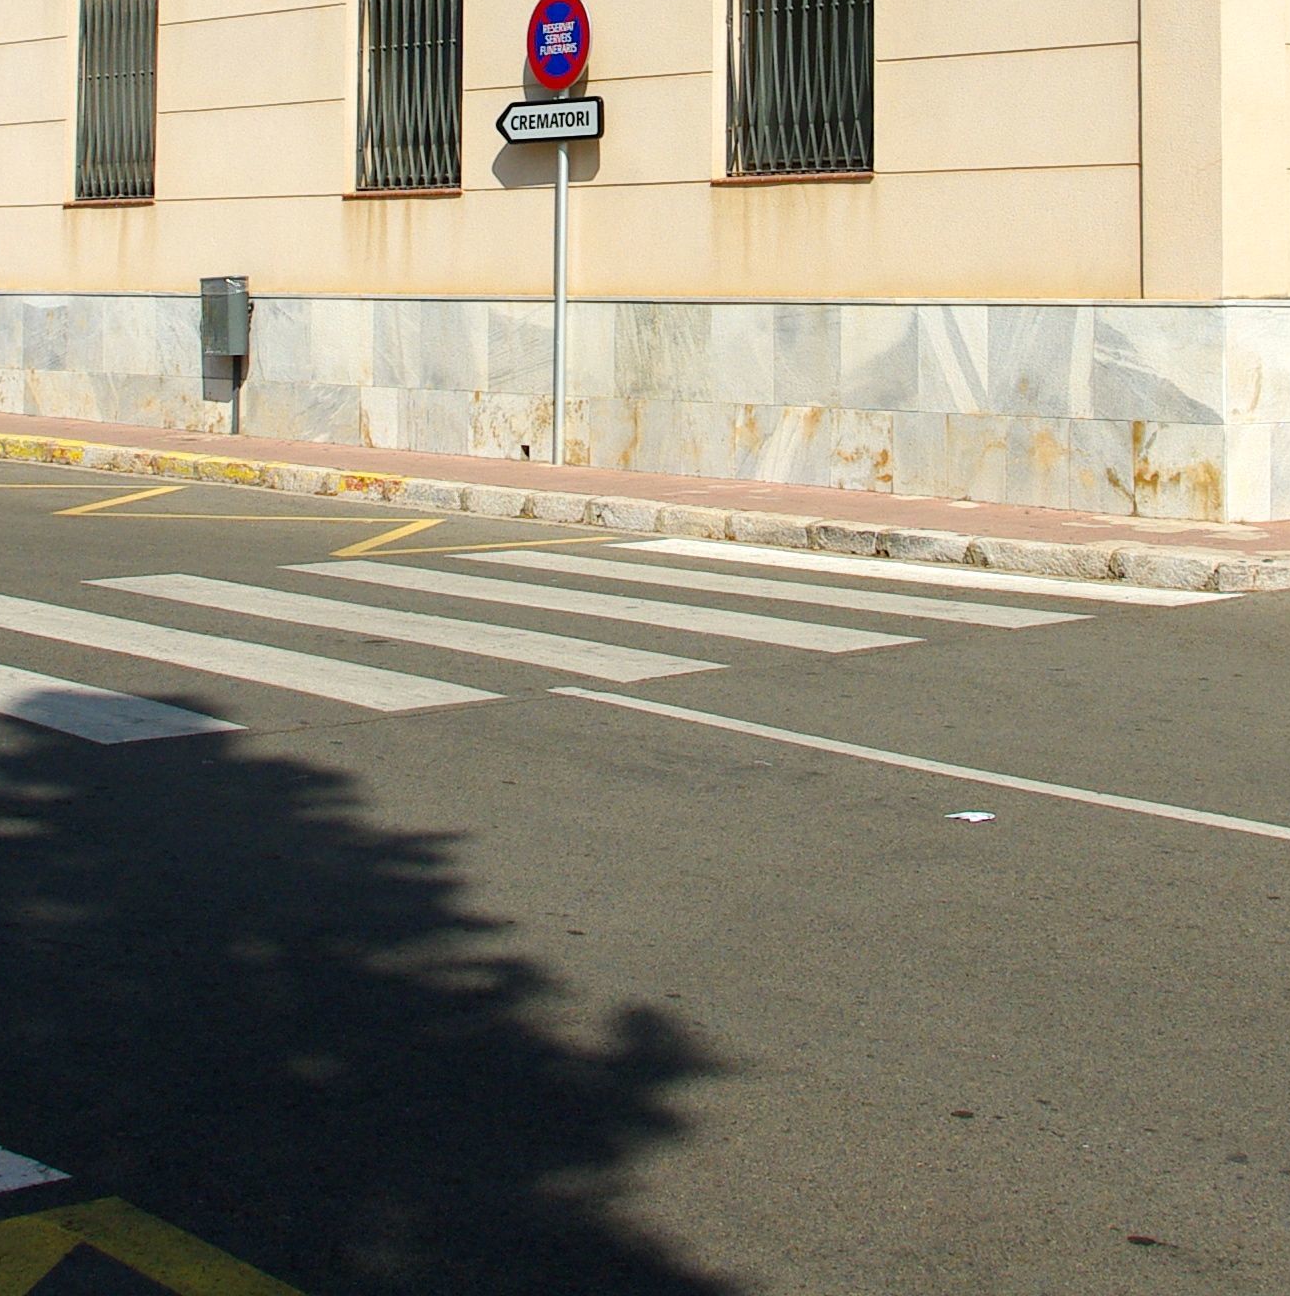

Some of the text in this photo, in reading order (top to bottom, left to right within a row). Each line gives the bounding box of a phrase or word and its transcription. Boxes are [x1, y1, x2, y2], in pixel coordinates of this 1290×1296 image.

[542, 21, 575, 34] RESERVAT
[545, 32, 572, 44] SERVEIS
[540, 43, 577, 56] FUNERARIS
[510, 110, 589, 131] CREMATORI
